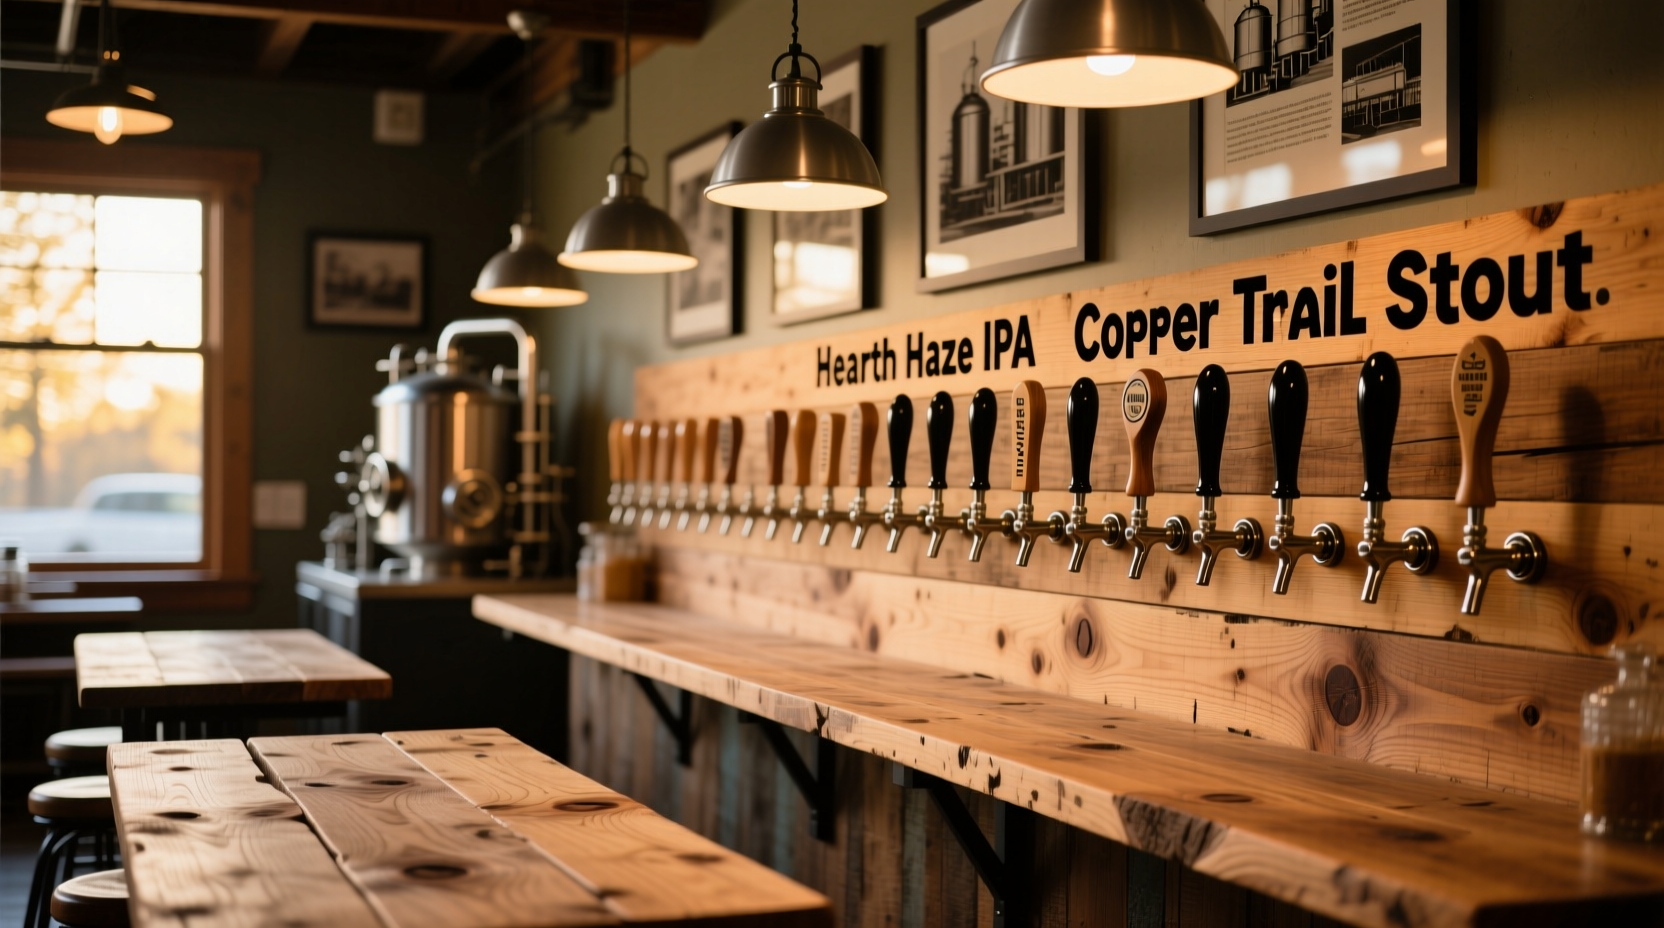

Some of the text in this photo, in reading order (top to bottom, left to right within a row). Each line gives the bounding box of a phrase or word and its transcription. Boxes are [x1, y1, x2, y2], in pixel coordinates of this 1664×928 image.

[1074, 298, 1220, 363] Copper
[1385, 229, 1611, 331] Stout.
[817, 314, 1036, 388] Hearth Haze IPA
